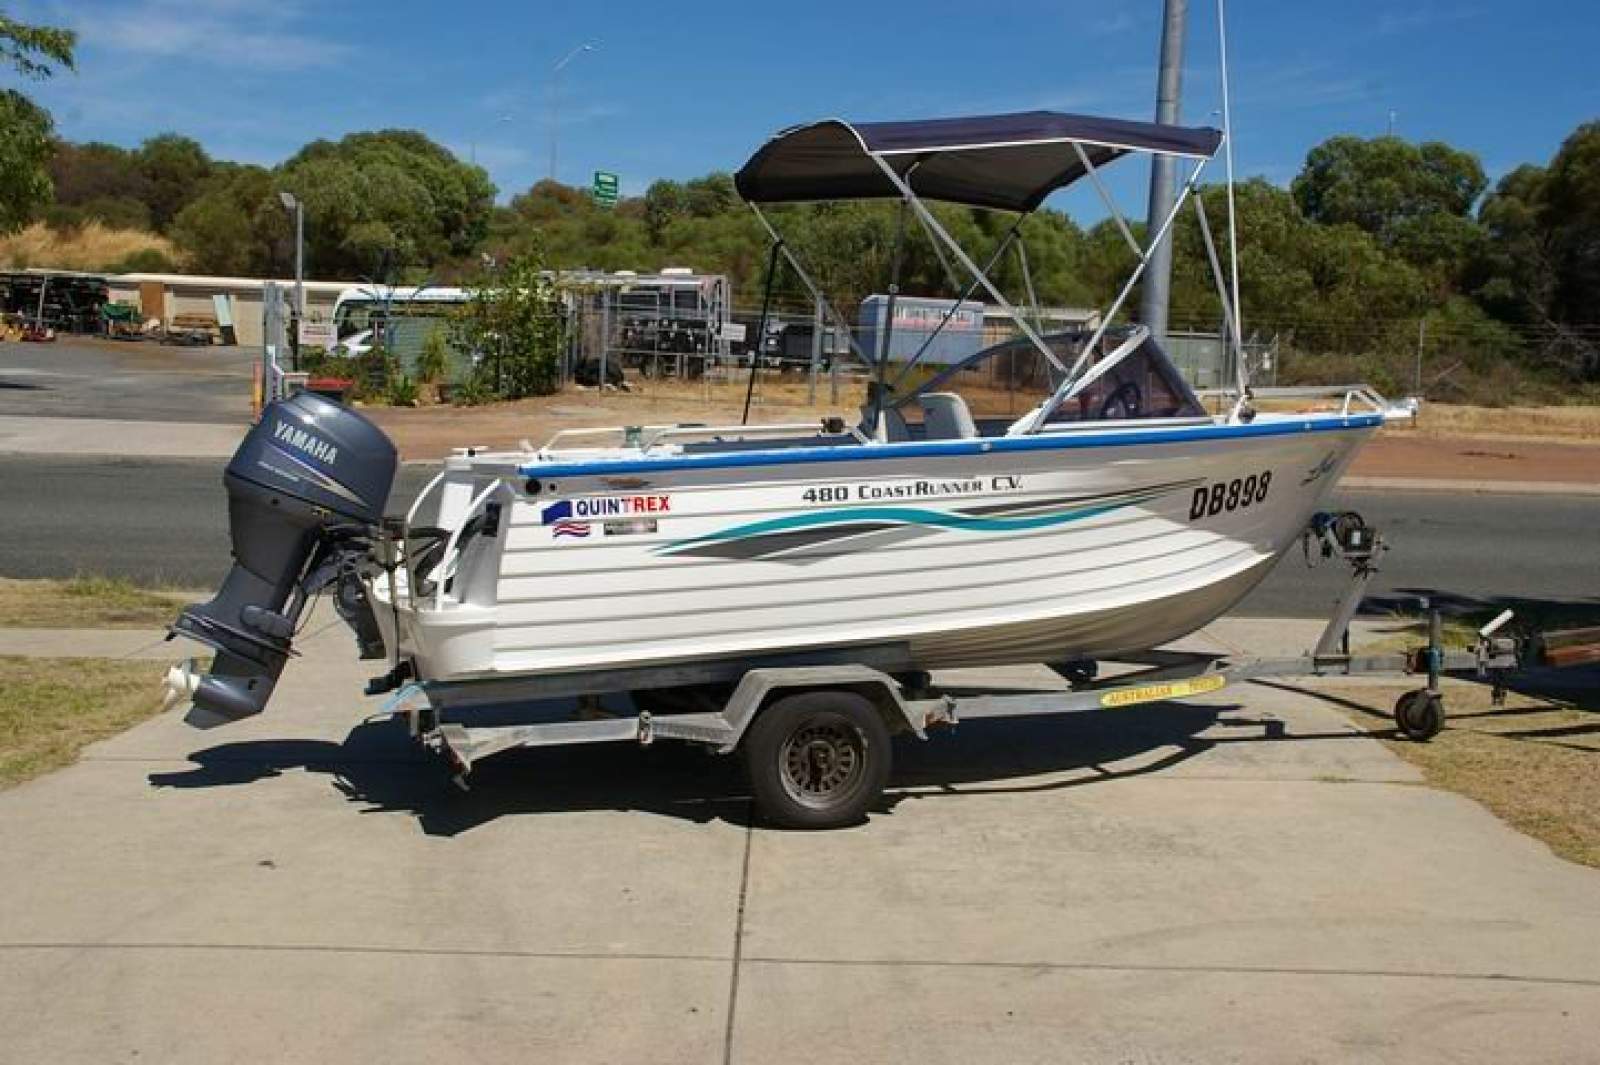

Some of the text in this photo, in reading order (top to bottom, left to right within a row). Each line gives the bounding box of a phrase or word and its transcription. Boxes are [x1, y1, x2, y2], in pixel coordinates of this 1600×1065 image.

[273, 420, 338, 465] YAMAHA
[576, 496, 670, 516] QUINTREX
[802, 486, 849, 502] 480
[1189, 469, 1273, 521] DB898
